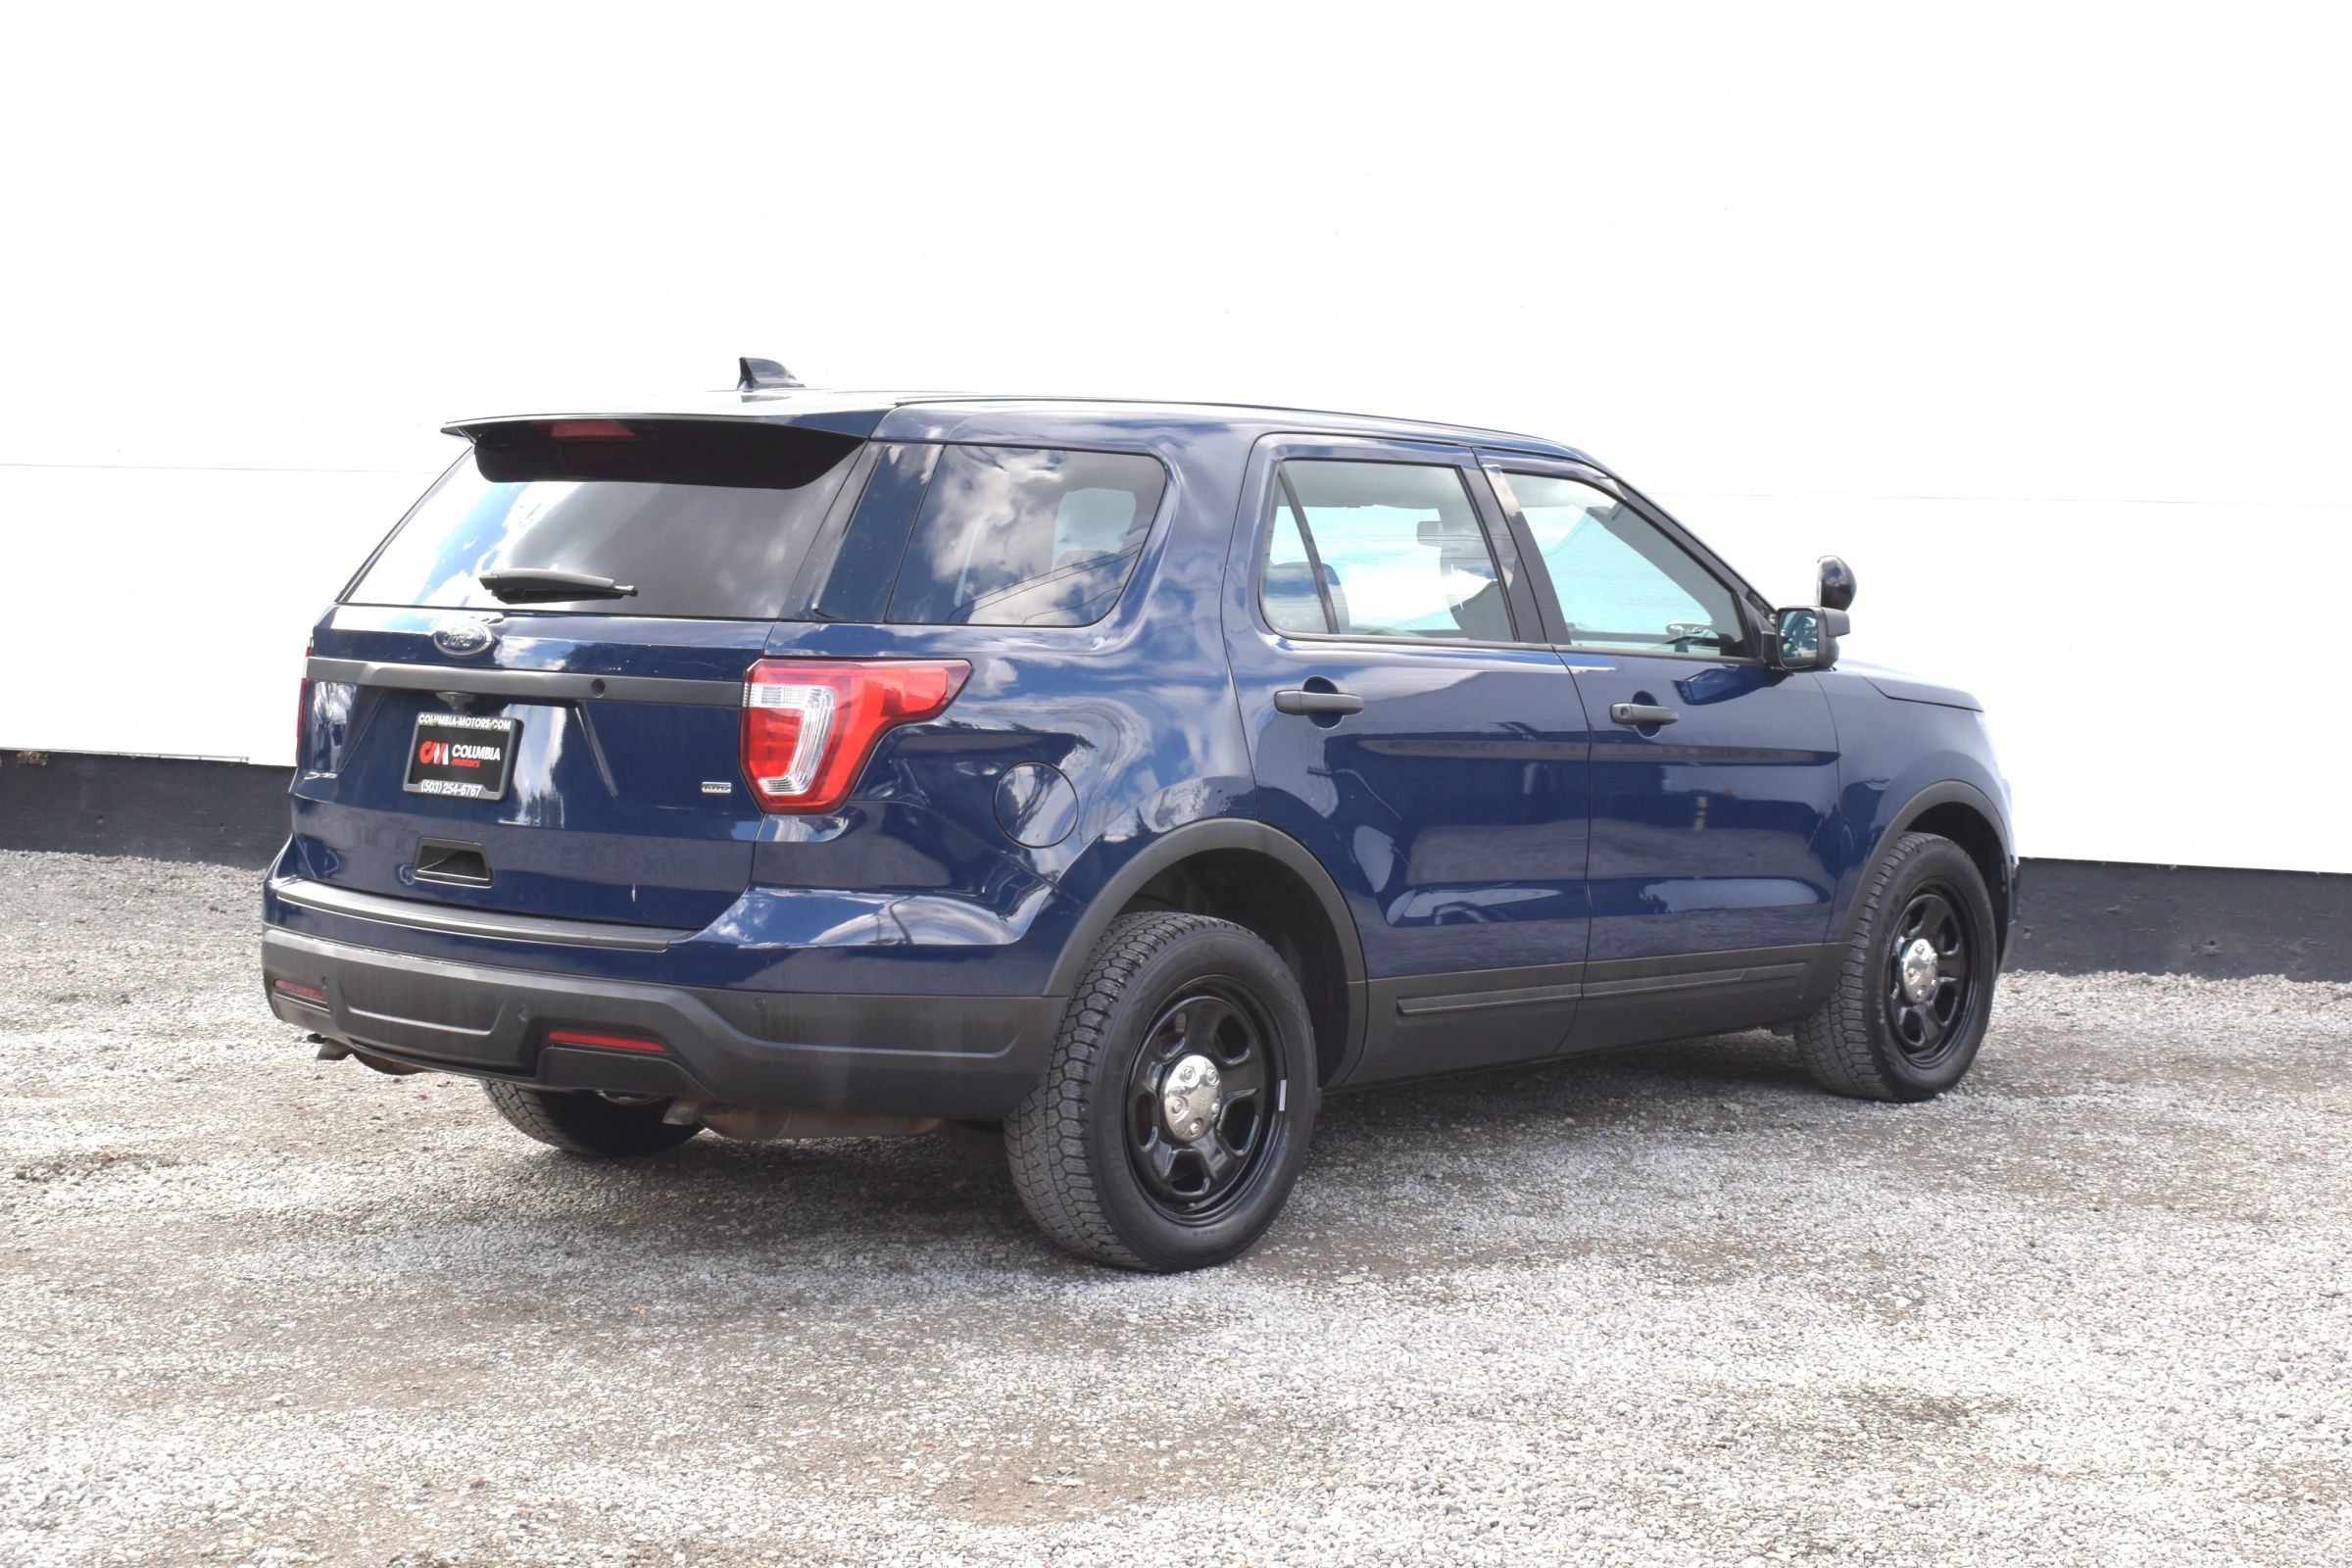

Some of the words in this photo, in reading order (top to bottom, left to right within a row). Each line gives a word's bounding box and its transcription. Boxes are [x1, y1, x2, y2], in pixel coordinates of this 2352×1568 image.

[418, 713, 512, 730] COLUMBIA-MOTORSCOM
[452, 744, 501, 760] COLUMBIA
[452, 759, 481, 767] motors
[420, 780, 442, 793] (503)
[443, 782, 482, 797] 254-6767
